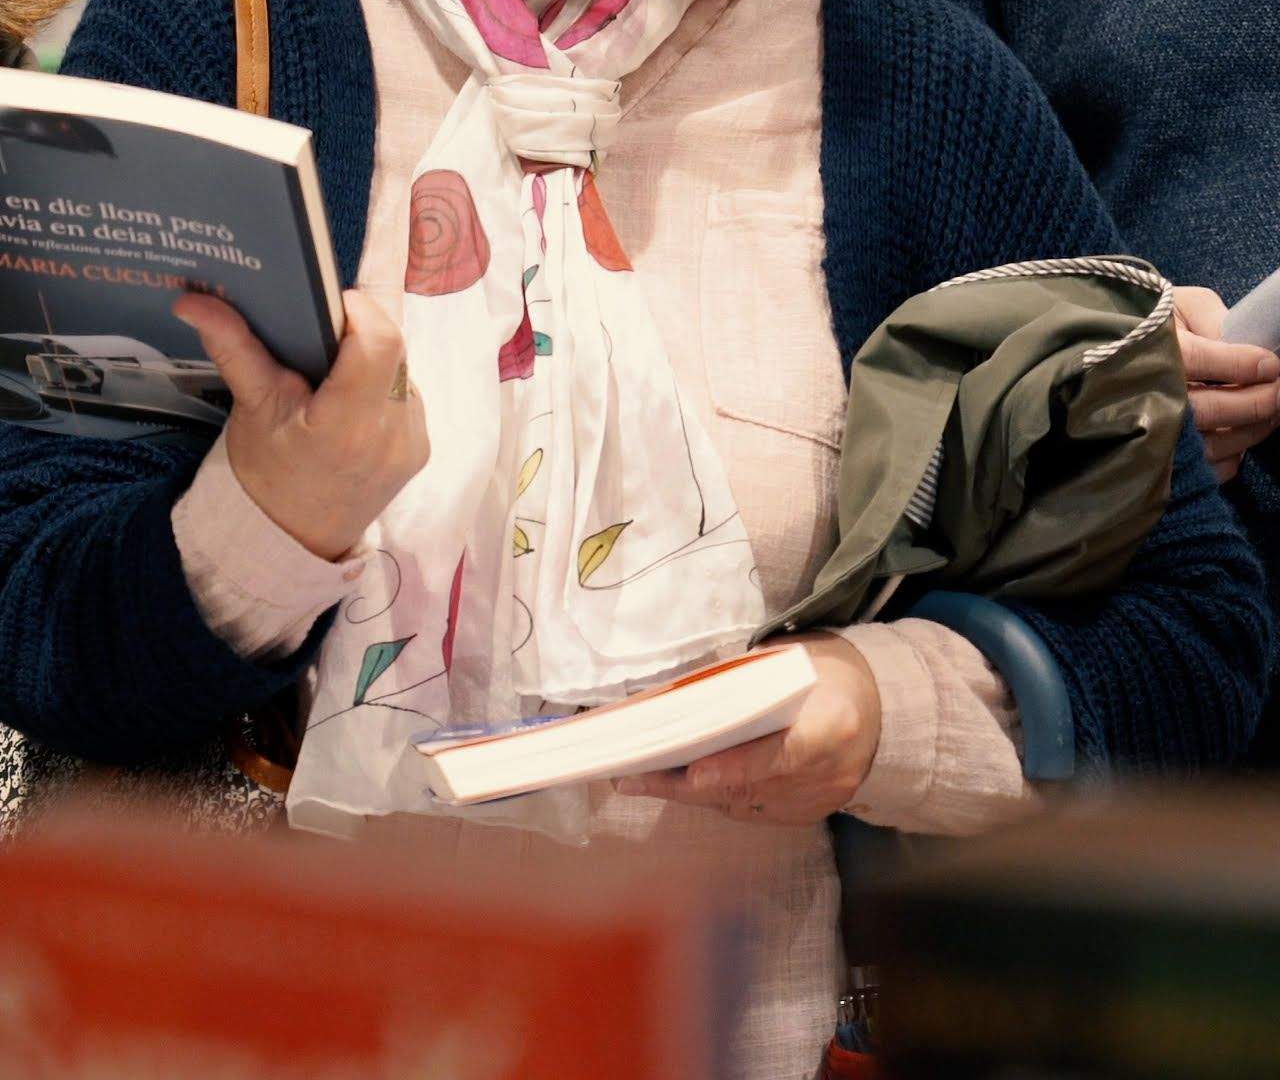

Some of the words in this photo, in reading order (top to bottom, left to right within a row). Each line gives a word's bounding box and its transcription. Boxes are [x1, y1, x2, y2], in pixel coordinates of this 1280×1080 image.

[5, 195, 41, 212] en
[48, 197, 94, 218] dic
[98, 201, 163, 227] llom
[170, 215, 235, 243] però
[32, 239, 102, 255] reflexions
[104, 247, 143, 260] sobre
[144, 250, 198, 269] llengua
[50, 221, 86, 238] en
[93, 224, 153, 246] deia
[159, 230, 263, 271] llomillo
